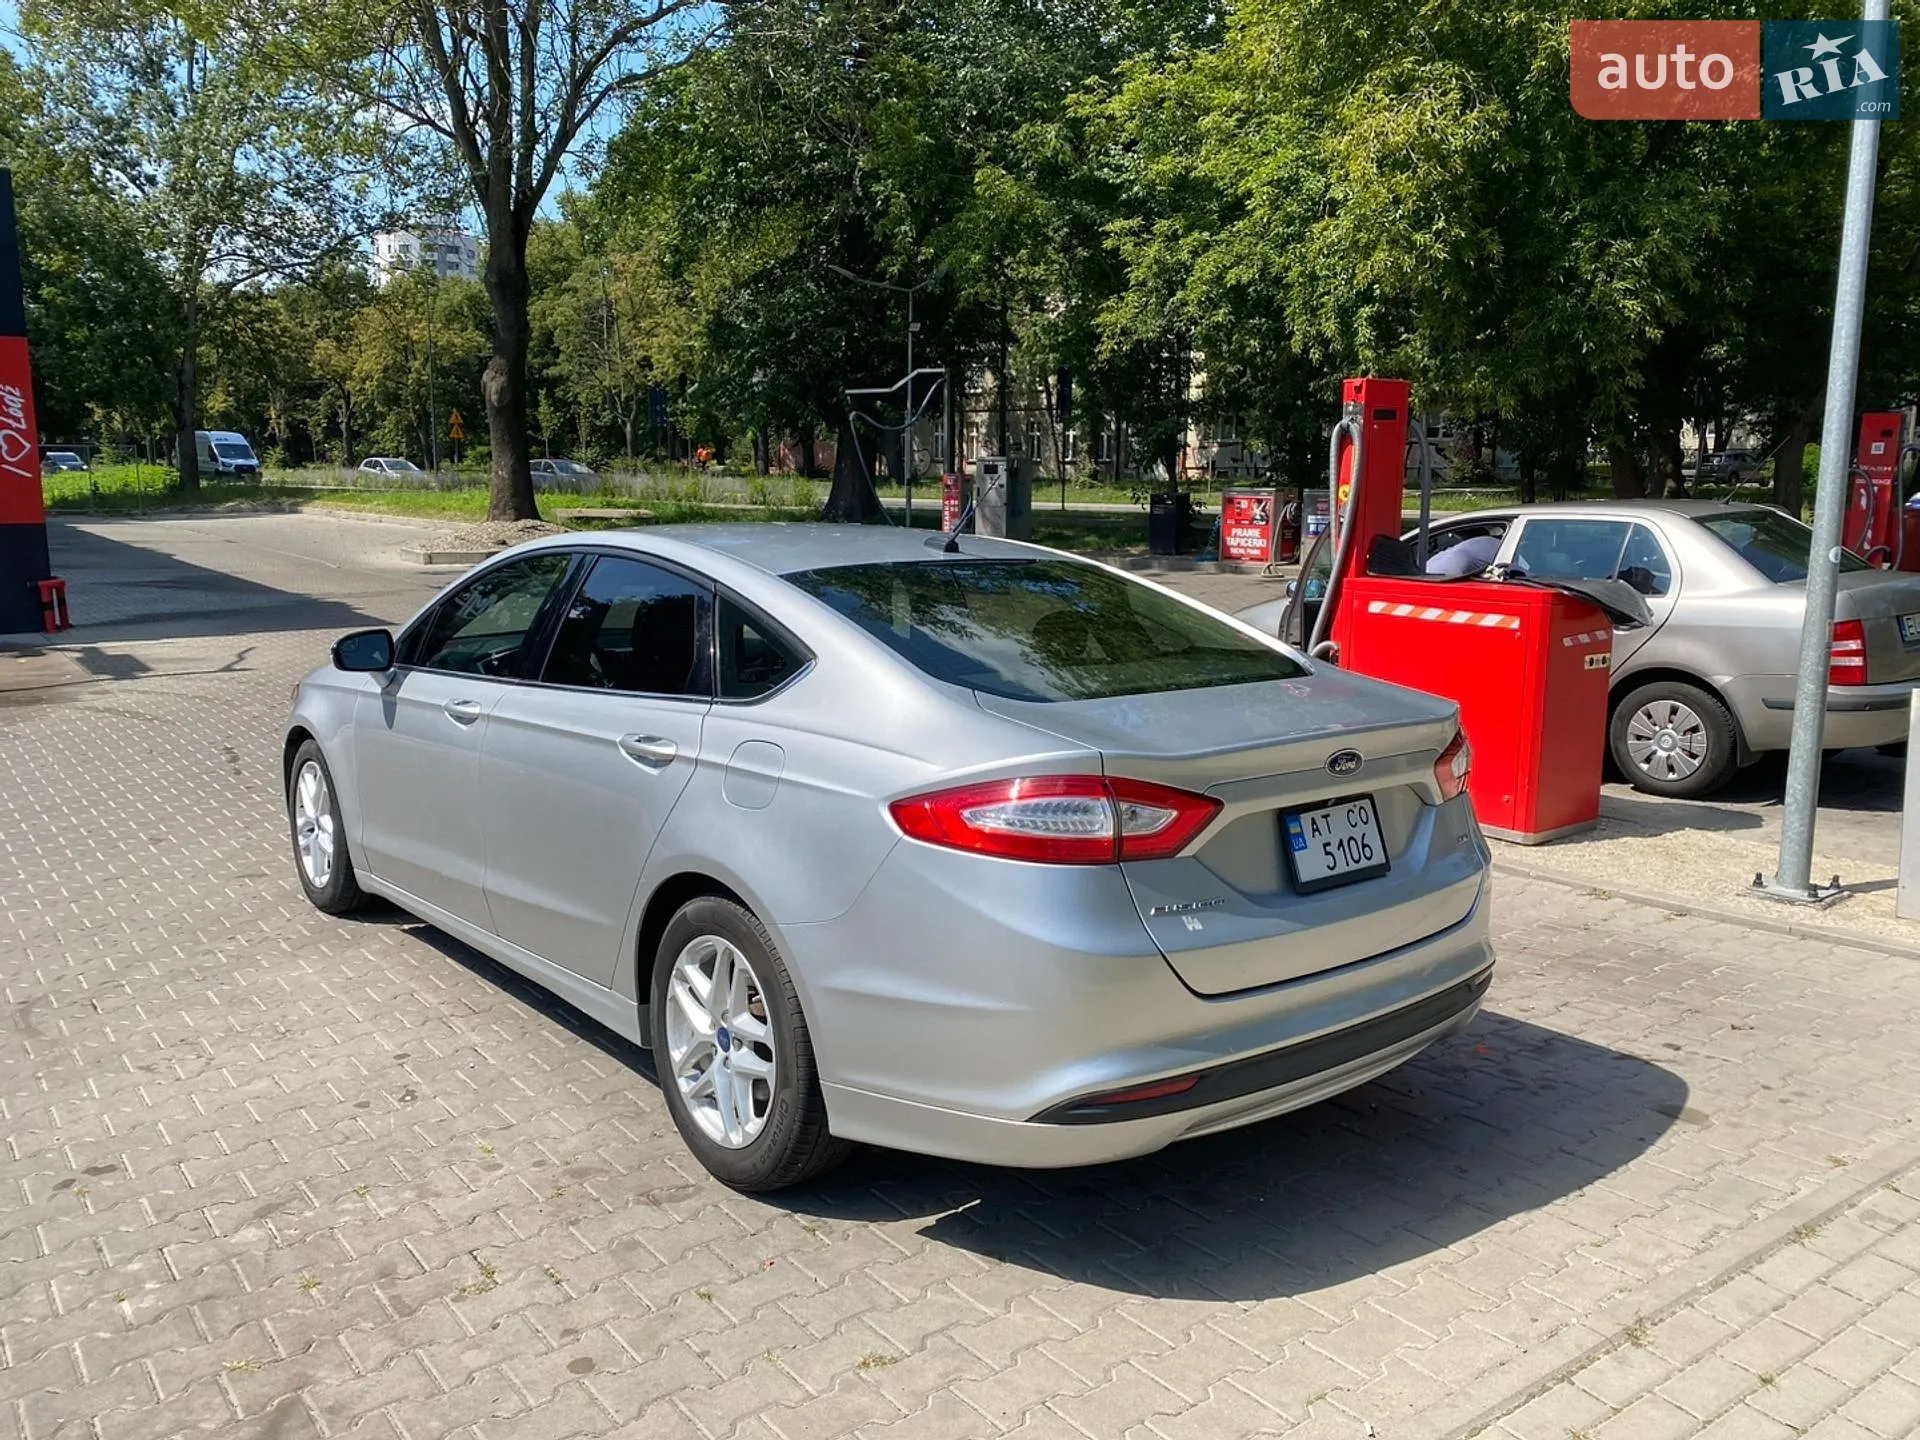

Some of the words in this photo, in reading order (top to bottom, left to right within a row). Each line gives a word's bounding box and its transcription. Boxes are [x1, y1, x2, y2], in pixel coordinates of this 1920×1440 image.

[1311, 813, 1332, 839] AT
[1346, 805, 1369, 828] CO
[1323, 832, 1374, 871] 5106
